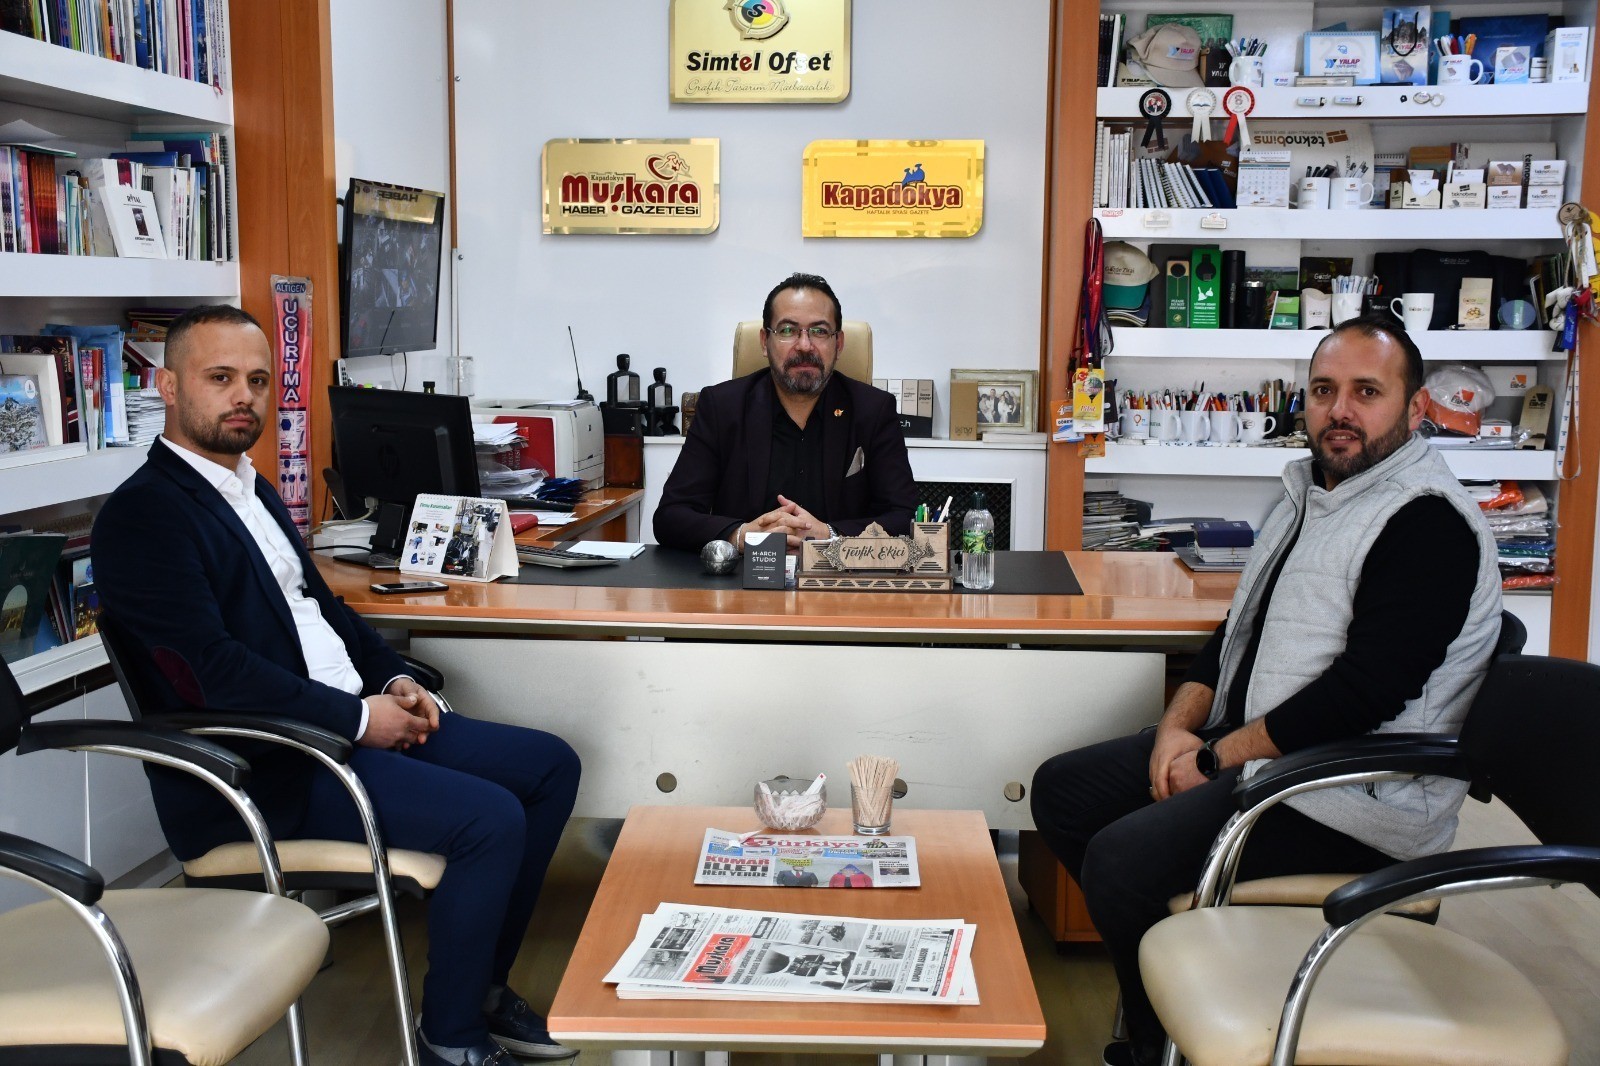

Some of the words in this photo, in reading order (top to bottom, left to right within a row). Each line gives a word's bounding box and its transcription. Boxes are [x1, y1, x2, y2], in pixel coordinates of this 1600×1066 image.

[686, 52, 761, 72] Simtel
[768, 52, 832, 75] Ofset
[685, 79, 723, 96] Grafik
[769, 79, 834, 93] Matbaacılık
[1253, 133, 1326, 147] teknobims
[591, 174, 624, 182] Kapadokya
[823, 184, 961, 208] Kapadokya
[563, 205, 606, 215] HABER
[276, 284, 305, 292] ALTIGEN
[842, 545, 876, 560] Tevfik
[877, 545, 906, 561] Ekici
[705, 856, 770, 865] KUMAR
